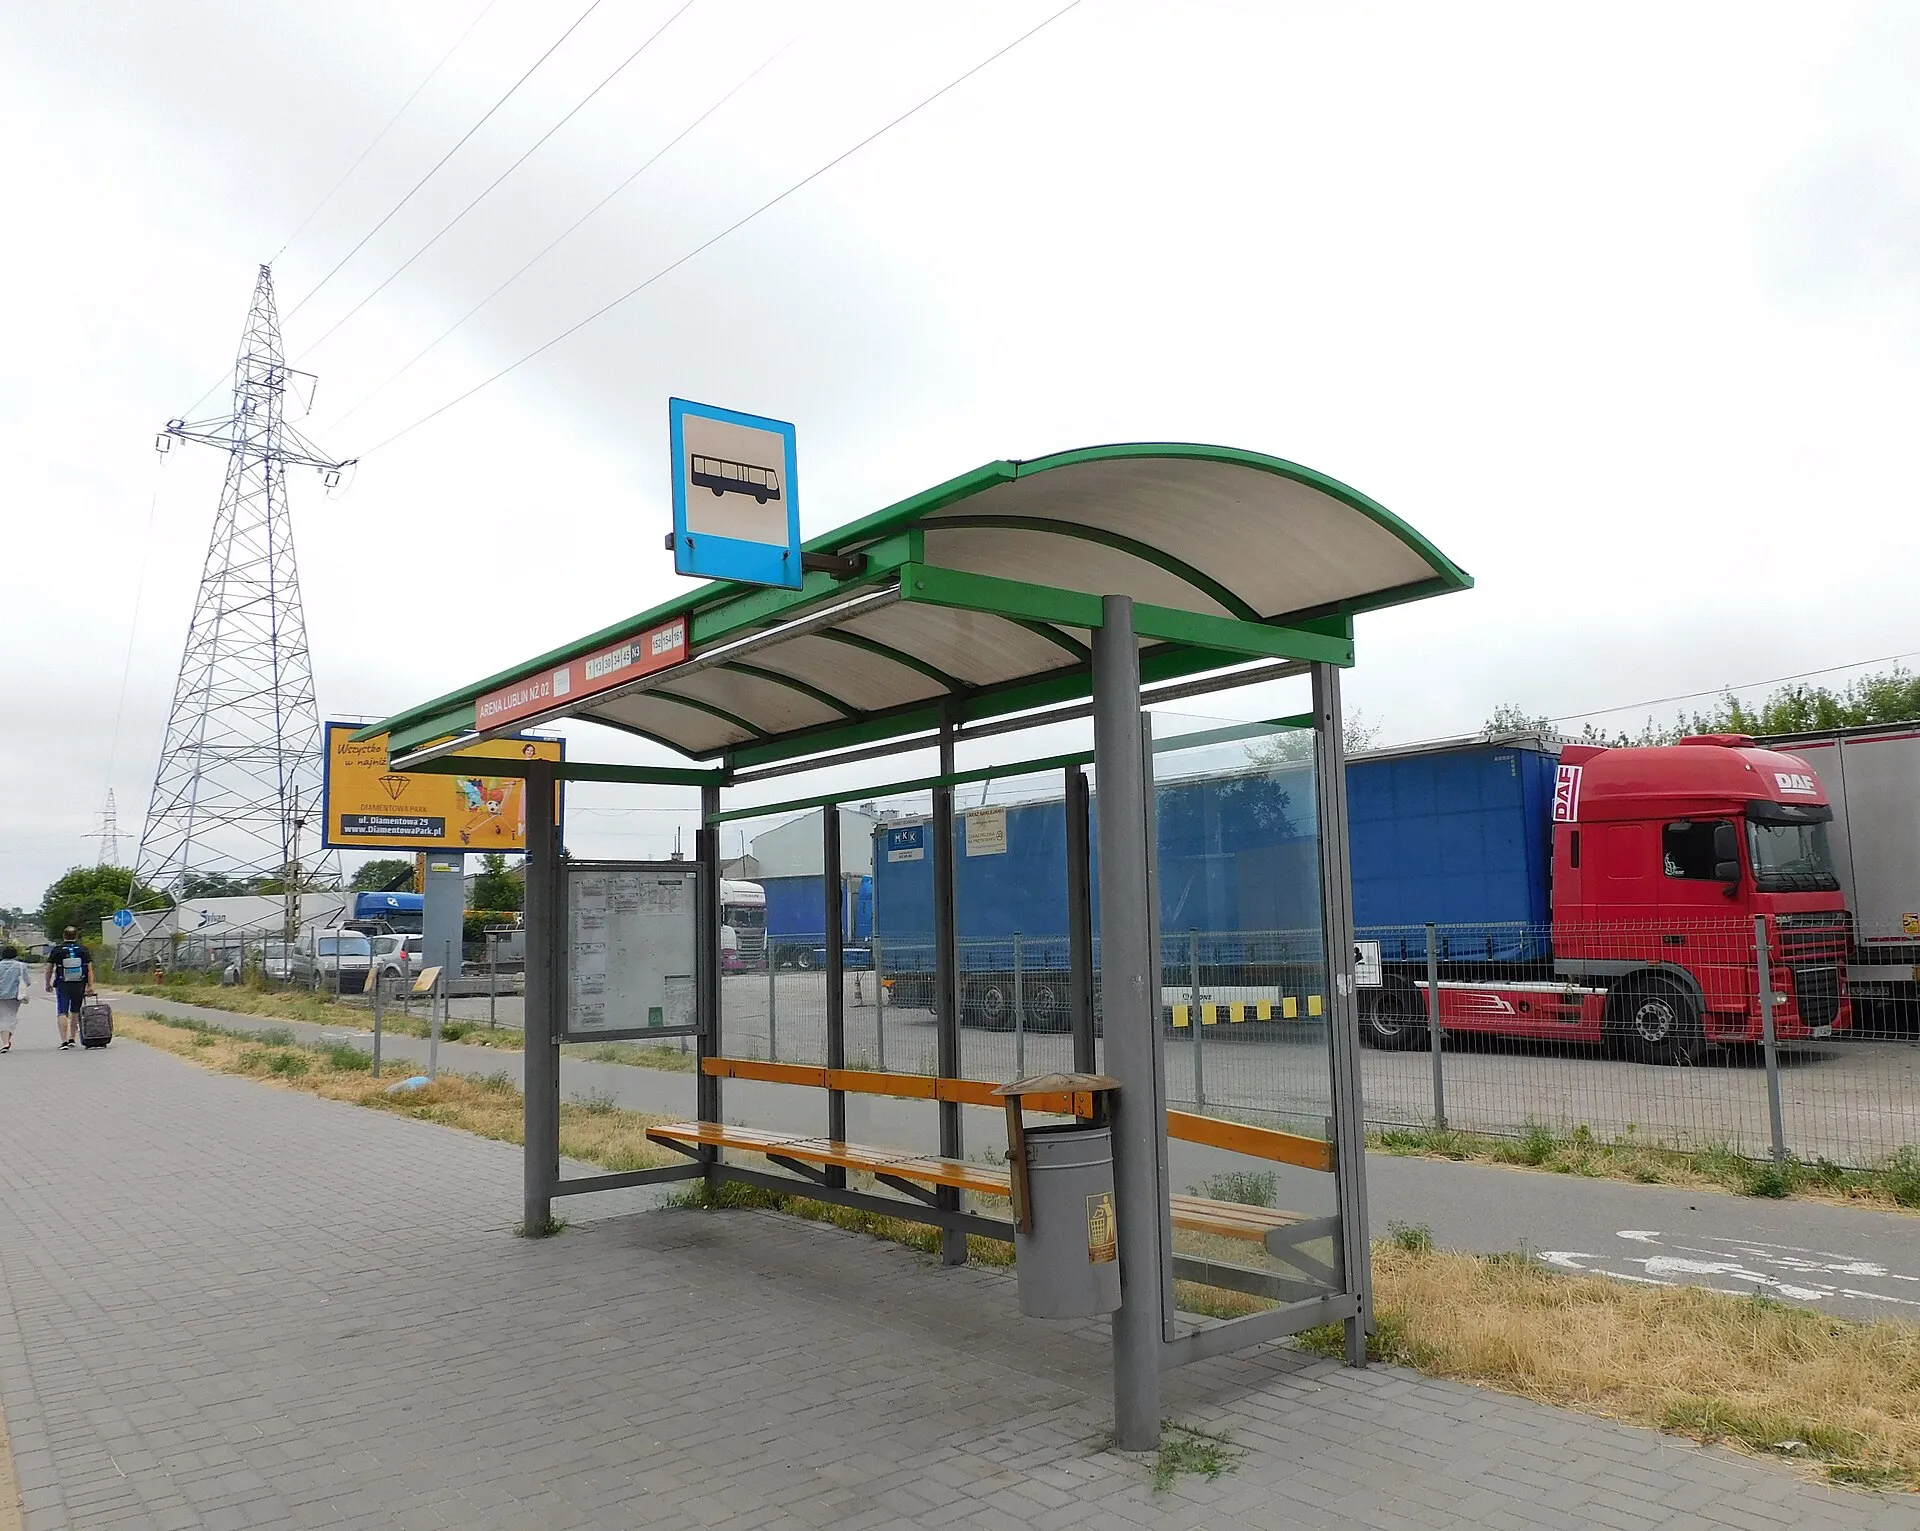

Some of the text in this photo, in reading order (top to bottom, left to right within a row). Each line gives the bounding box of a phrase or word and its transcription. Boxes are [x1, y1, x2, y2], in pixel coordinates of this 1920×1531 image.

[480, 681, 550, 719] ARENA LUBLIN NŻ 02
[337, 743, 381, 755] Wszystko
[1774, 773, 1814, 790] DAF
[1555, 767, 1571, 820] DAF
[360, 803, 428, 813] DIAMENTOWA PARK
[358, 816, 429, 826] ul. Diamentowa 29
[344, 825, 442, 837] www.DiamentowaPark.pl
[895, 831, 916, 843] MKK
